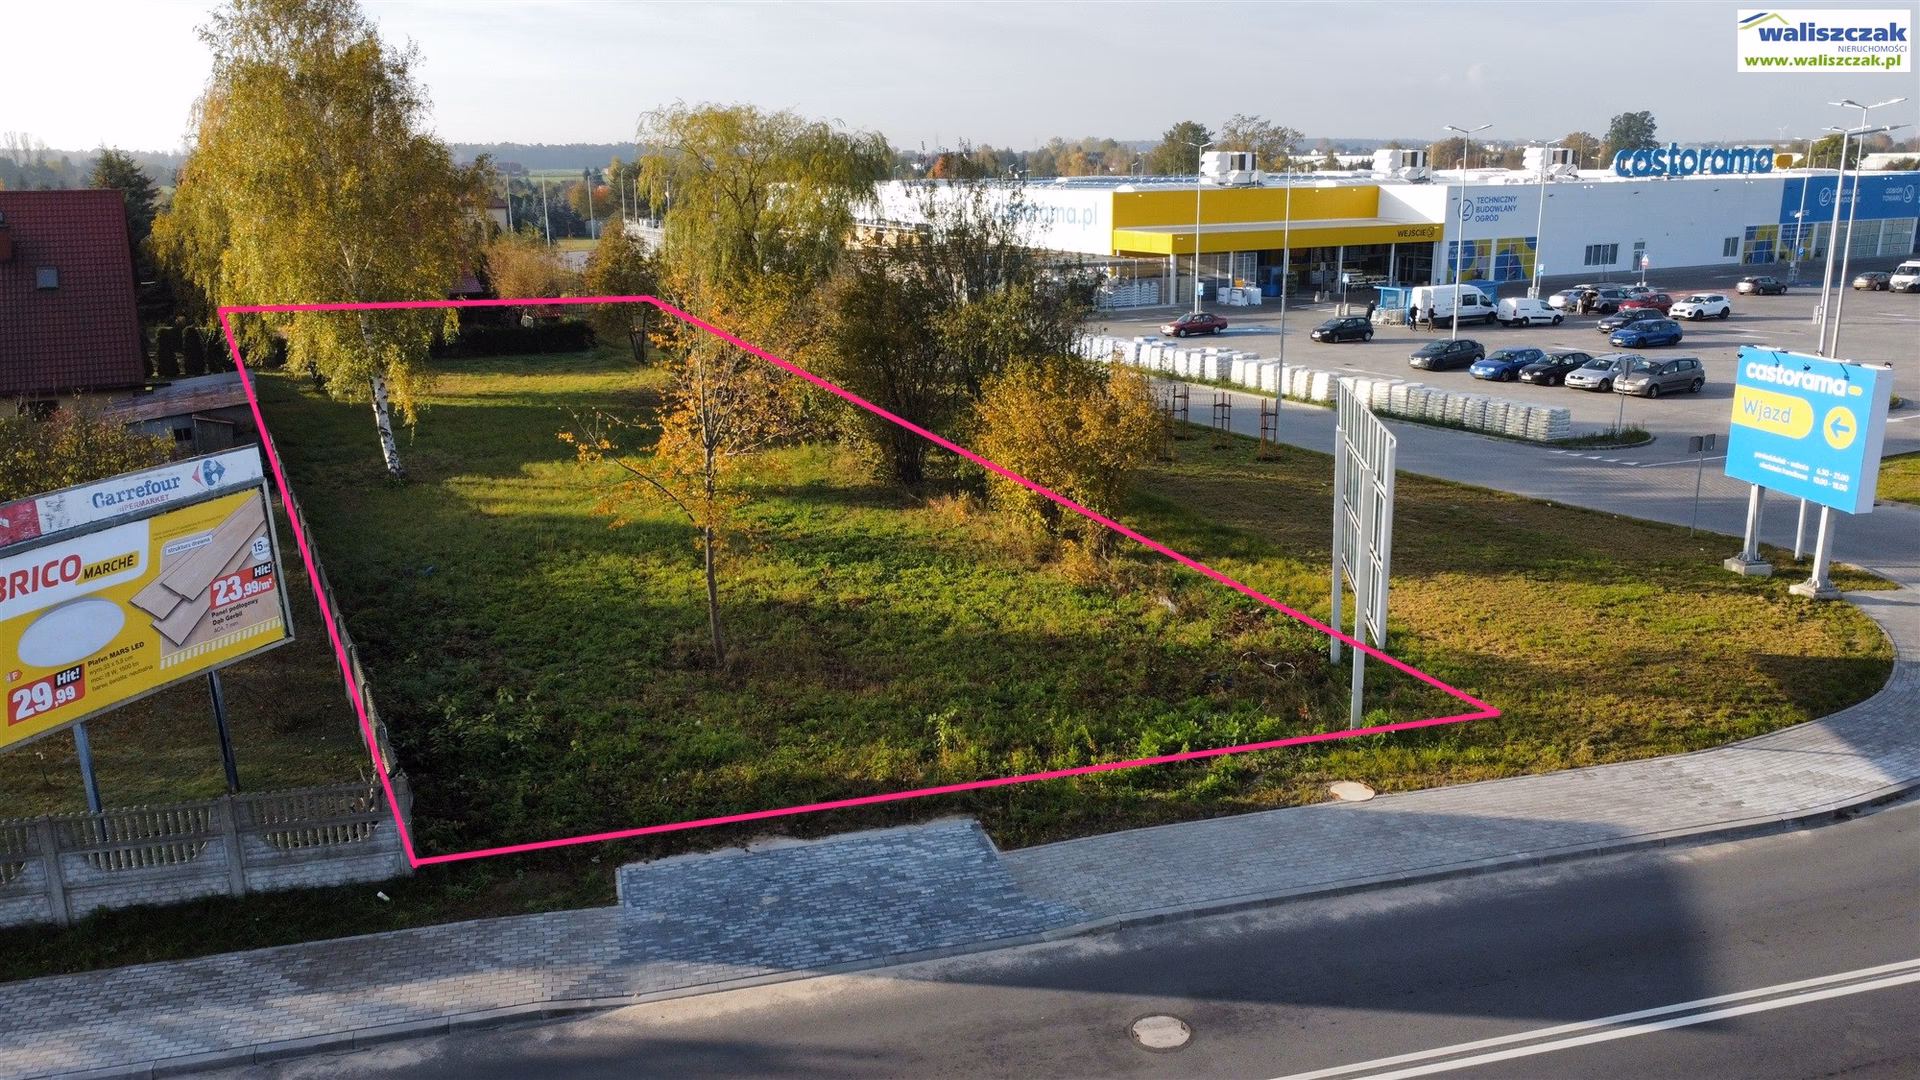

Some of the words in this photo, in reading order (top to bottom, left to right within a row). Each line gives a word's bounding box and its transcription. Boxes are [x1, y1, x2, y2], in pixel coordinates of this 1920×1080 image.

[1614, 142, 1774, 178] castorama
[1475, 205, 1517, 214] BUDOWLANY
[1476, 196, 1518, 205] TECHNICZNY
[1475, 214, 1499, 223] OGRÓD
[1397, 228, 1426, 238] WEJŚCIE
[1746, 362, 1848, 397] castorama
[1743, 396, 1792, 424] Wjazd
[92, 476, 180, 509] Carrefour
[116, 494, 170, 513] HIPERMARKET
[253, 541, 264, 552] 15
[84, 554, 134, 580] MARCHÉ
[254, 563, 271, 577] Hit!
[211, 608, 228, 618] Panel
[109, 646, 130, 659] MARS
[131, 641, 145, 651] LED
[56, 667, 80, 686] Hit!
[13, 682, 76, 721] 29,99
